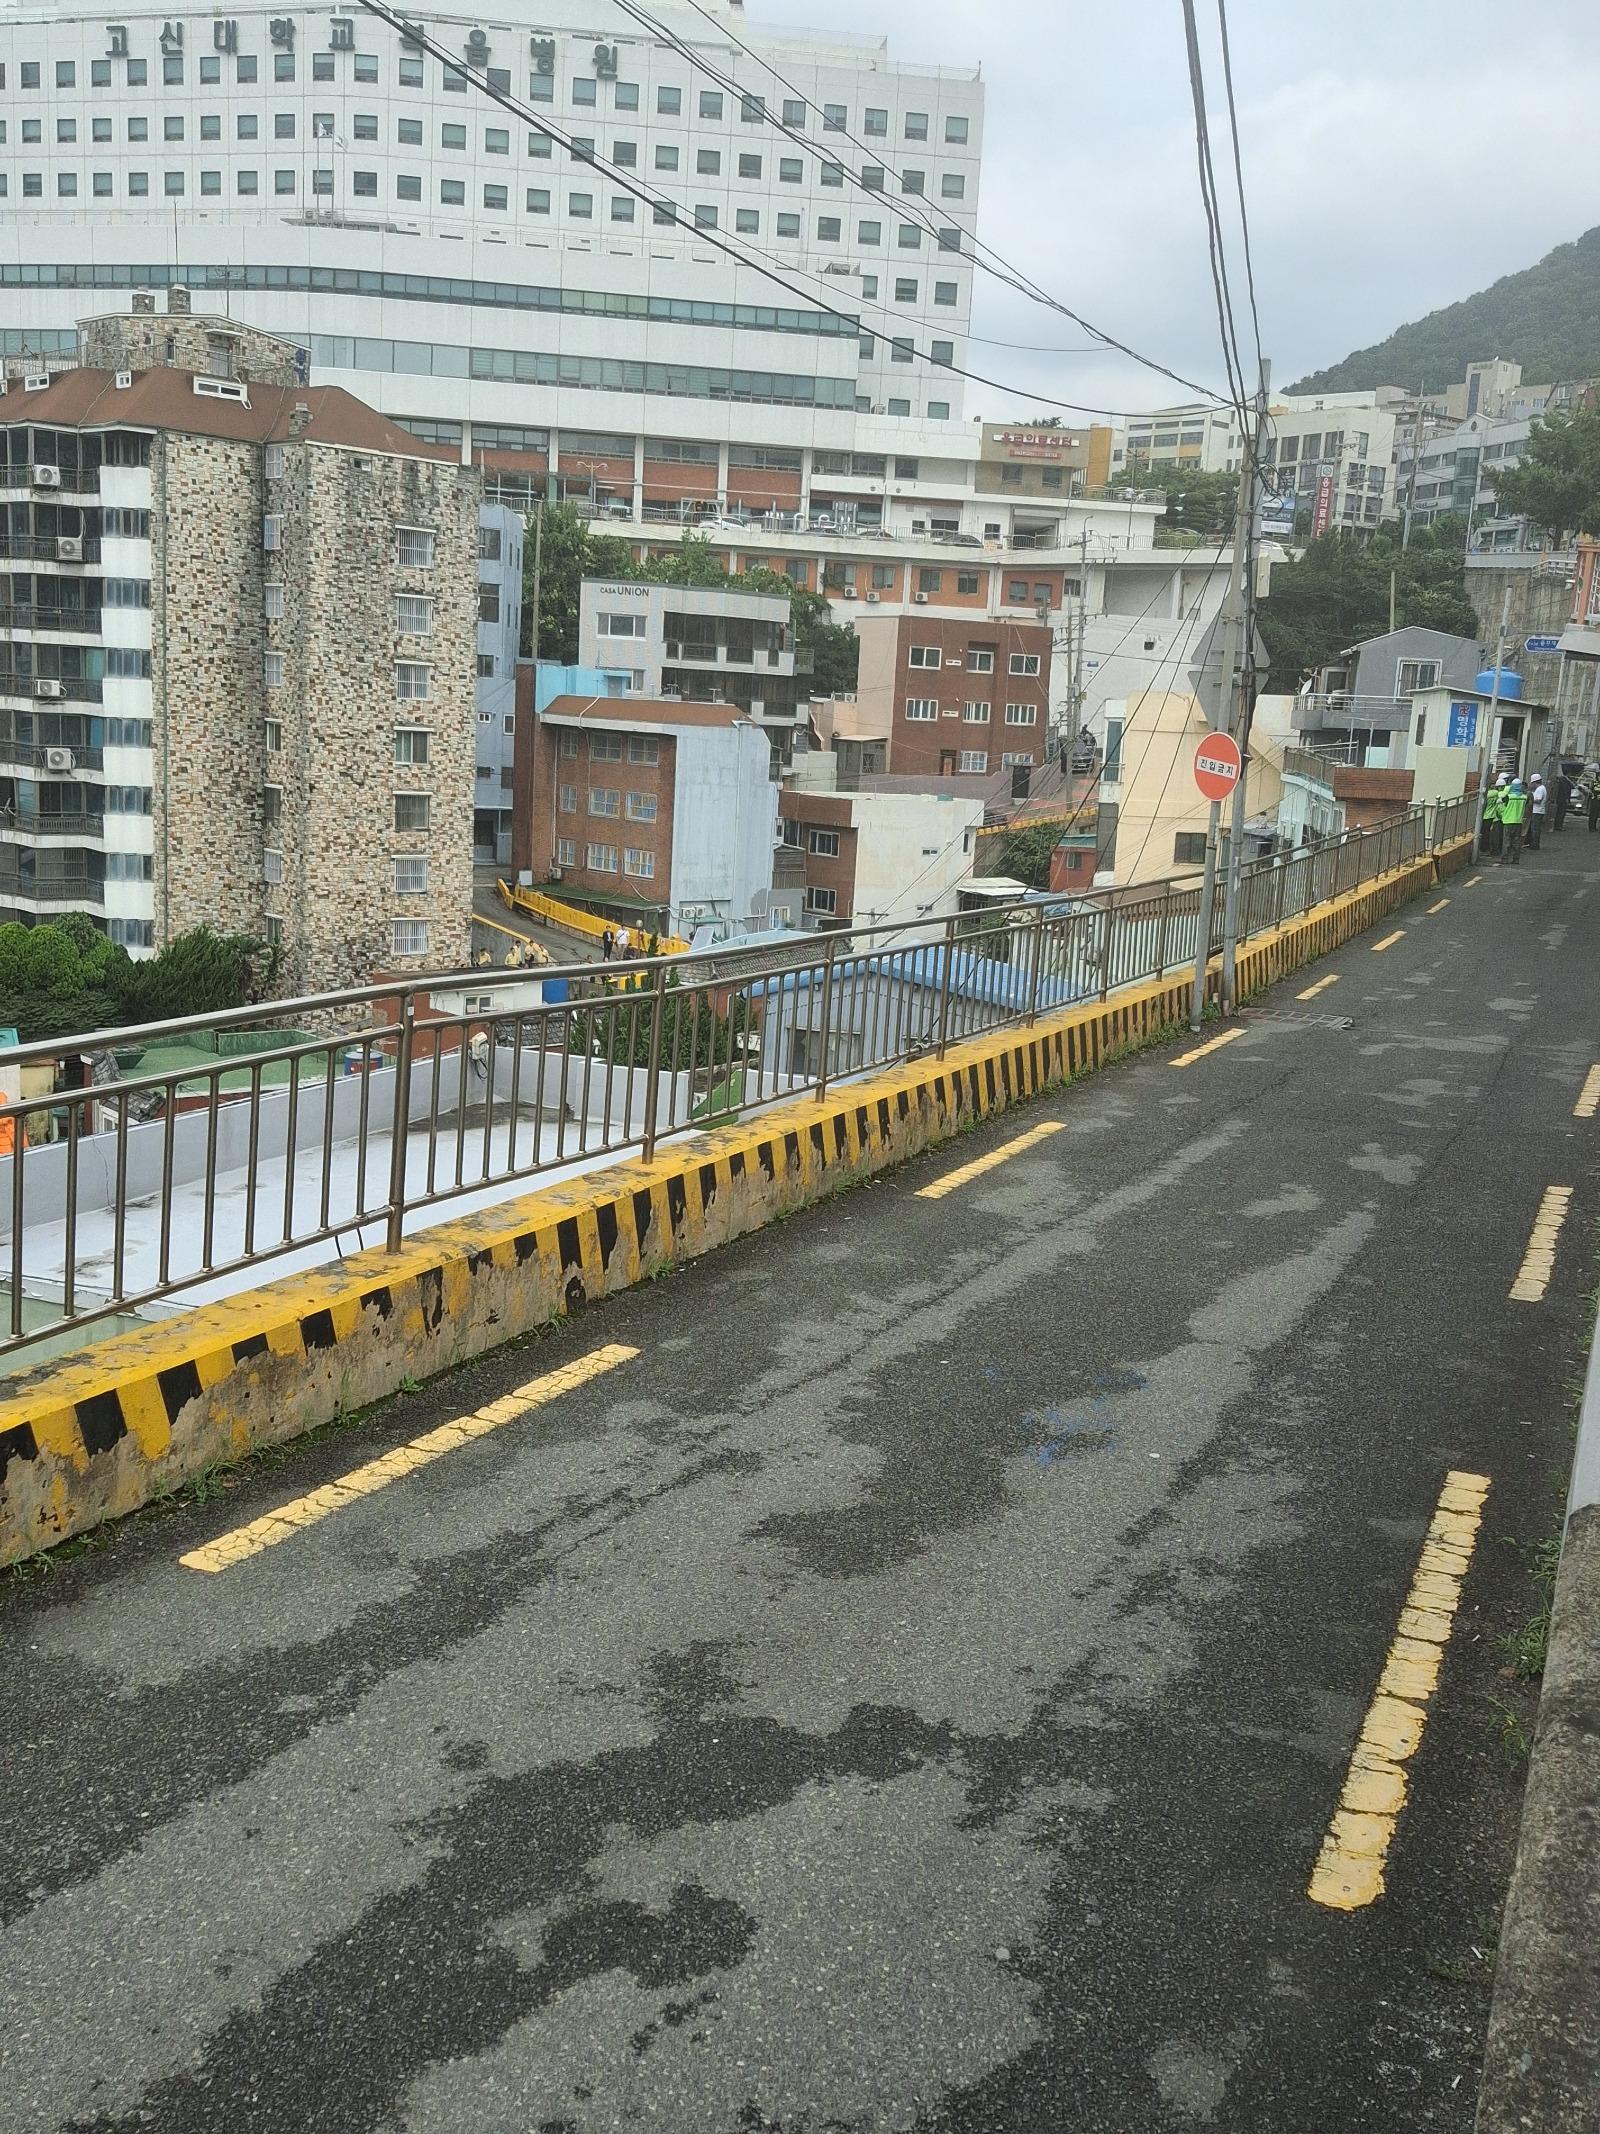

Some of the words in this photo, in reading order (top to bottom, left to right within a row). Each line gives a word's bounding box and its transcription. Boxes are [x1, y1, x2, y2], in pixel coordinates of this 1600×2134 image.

[1001, 431, 1073, 448] 응급의료센터
[617, 586, 650, 597] UNION
[1200, 758, 1234, 776] 진입금지
